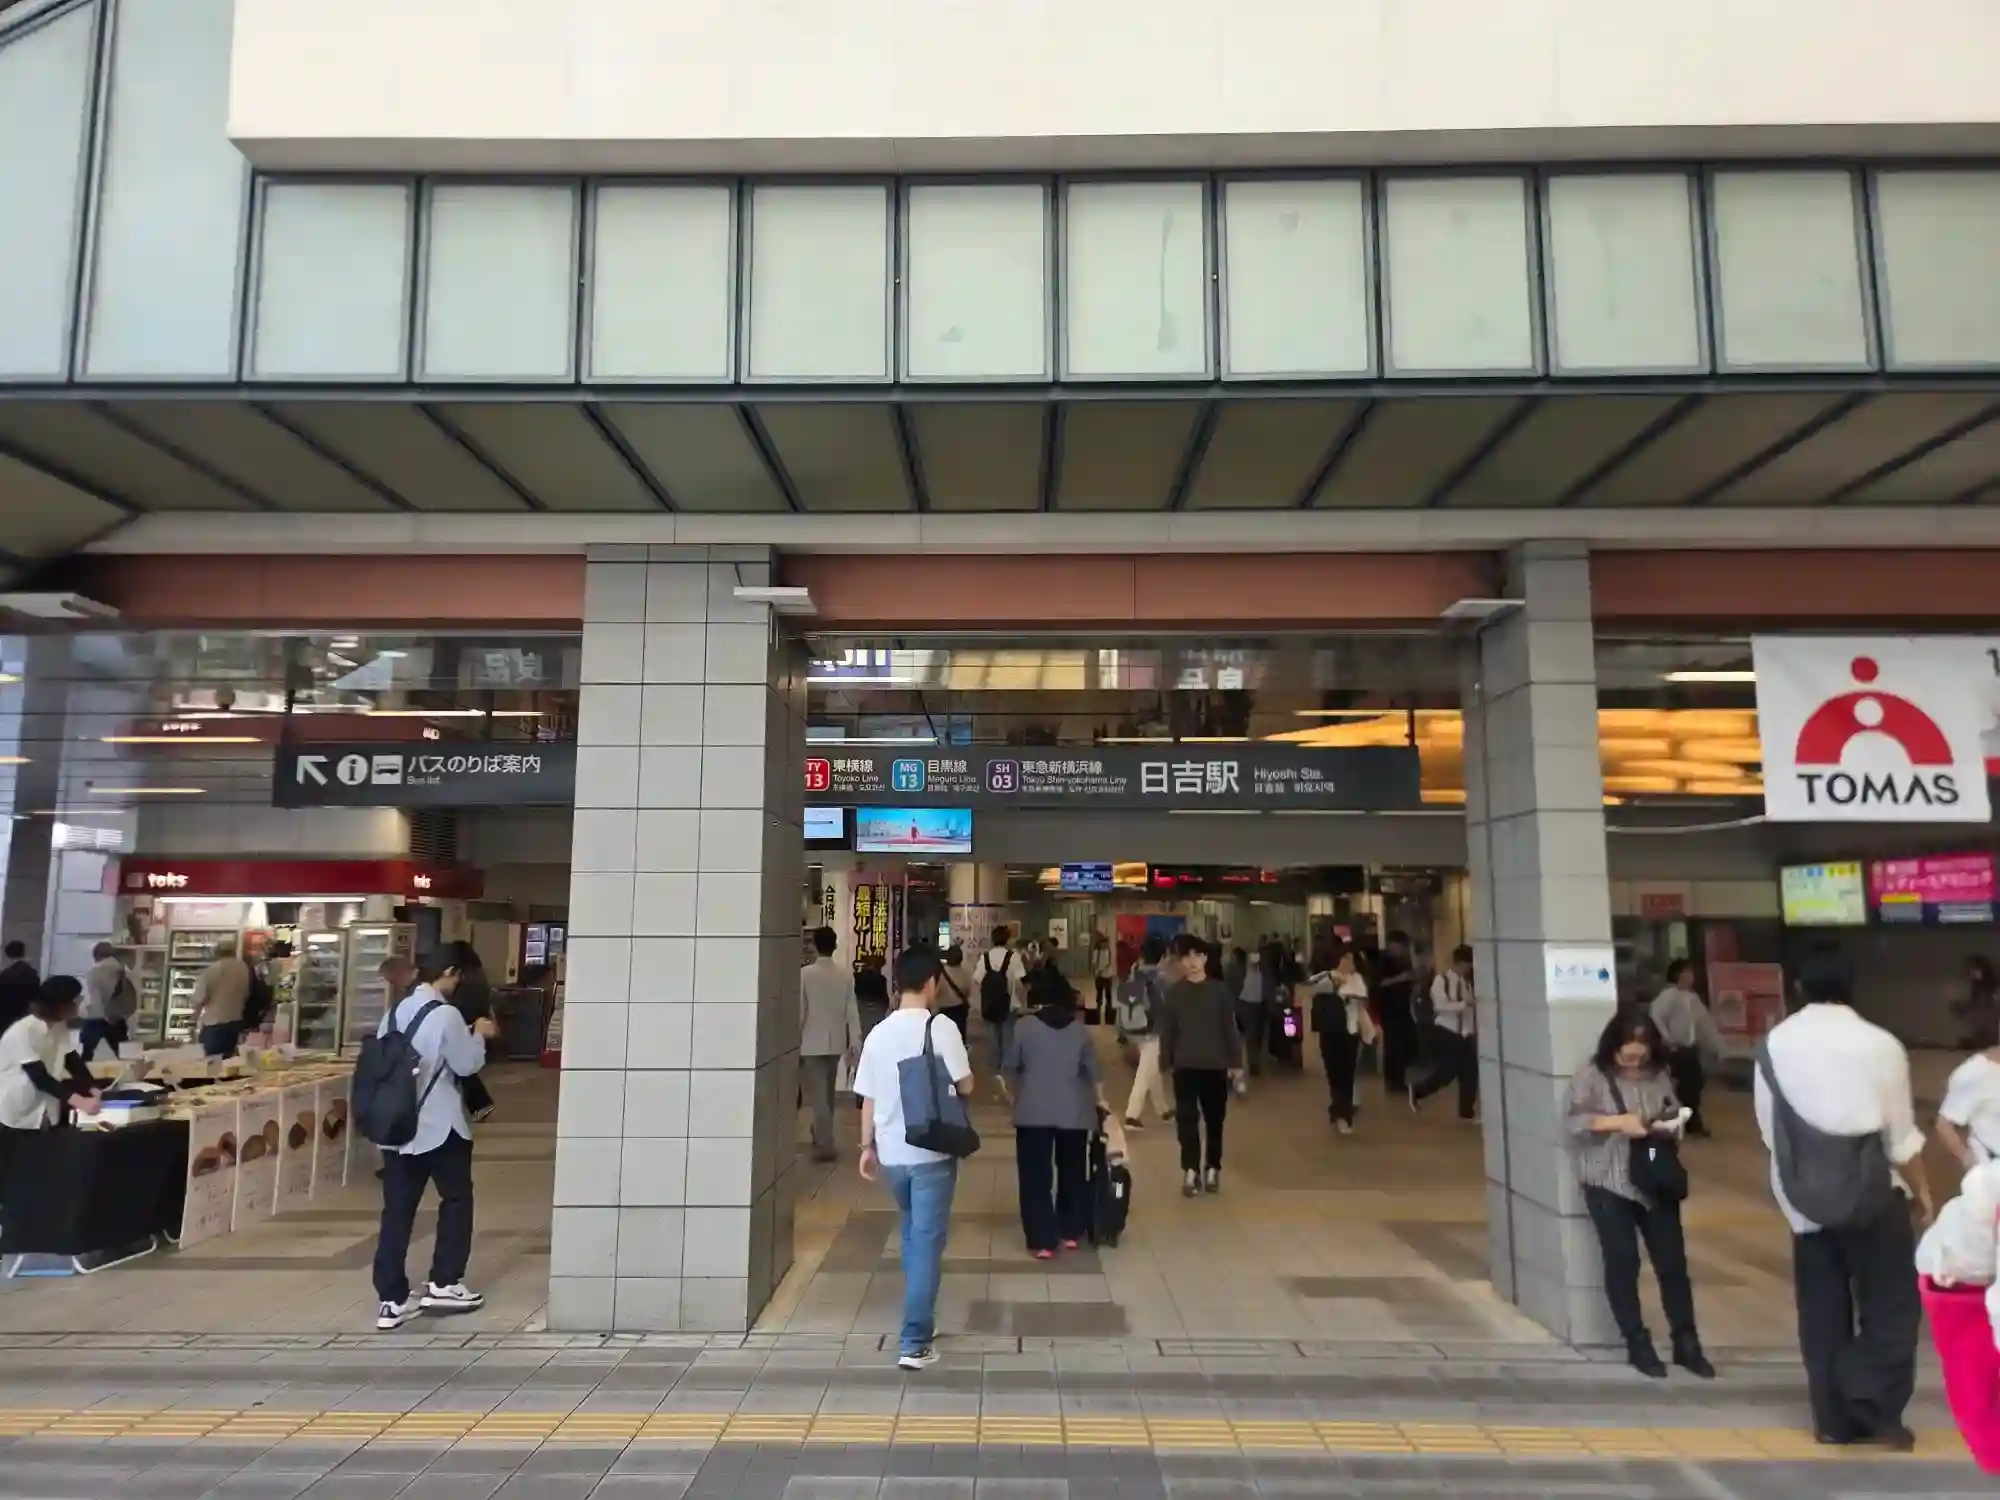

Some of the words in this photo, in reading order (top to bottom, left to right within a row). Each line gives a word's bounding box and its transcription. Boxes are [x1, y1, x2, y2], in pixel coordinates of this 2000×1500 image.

[407, 754, 541, 773] バスのりば案内
[807, 762, 821, 772] TY
[833, 759, 873, 773] 東横線
[900, 762, 917, 772] MG
[927, 759, 968, 773] 目黒線
[995, 763, 1010, 773] SH
[1021, 760, 1103, 774] 東急新横浜線
[833, 775, 860, 784] Toyoko
[862, 775, 879, 783] Line
[927, 775, 958, 784] Meguro
[1141, 760, 1240, 794] 日吉駅
[1254, 765, 1297, 781] Hiyoshi
[804, 774, 823, 787] 13
[899, 774, 918, 787] 13
[992, 775, 1012, 789] 03
[1796, 771, 1960, 806] TOMAS
